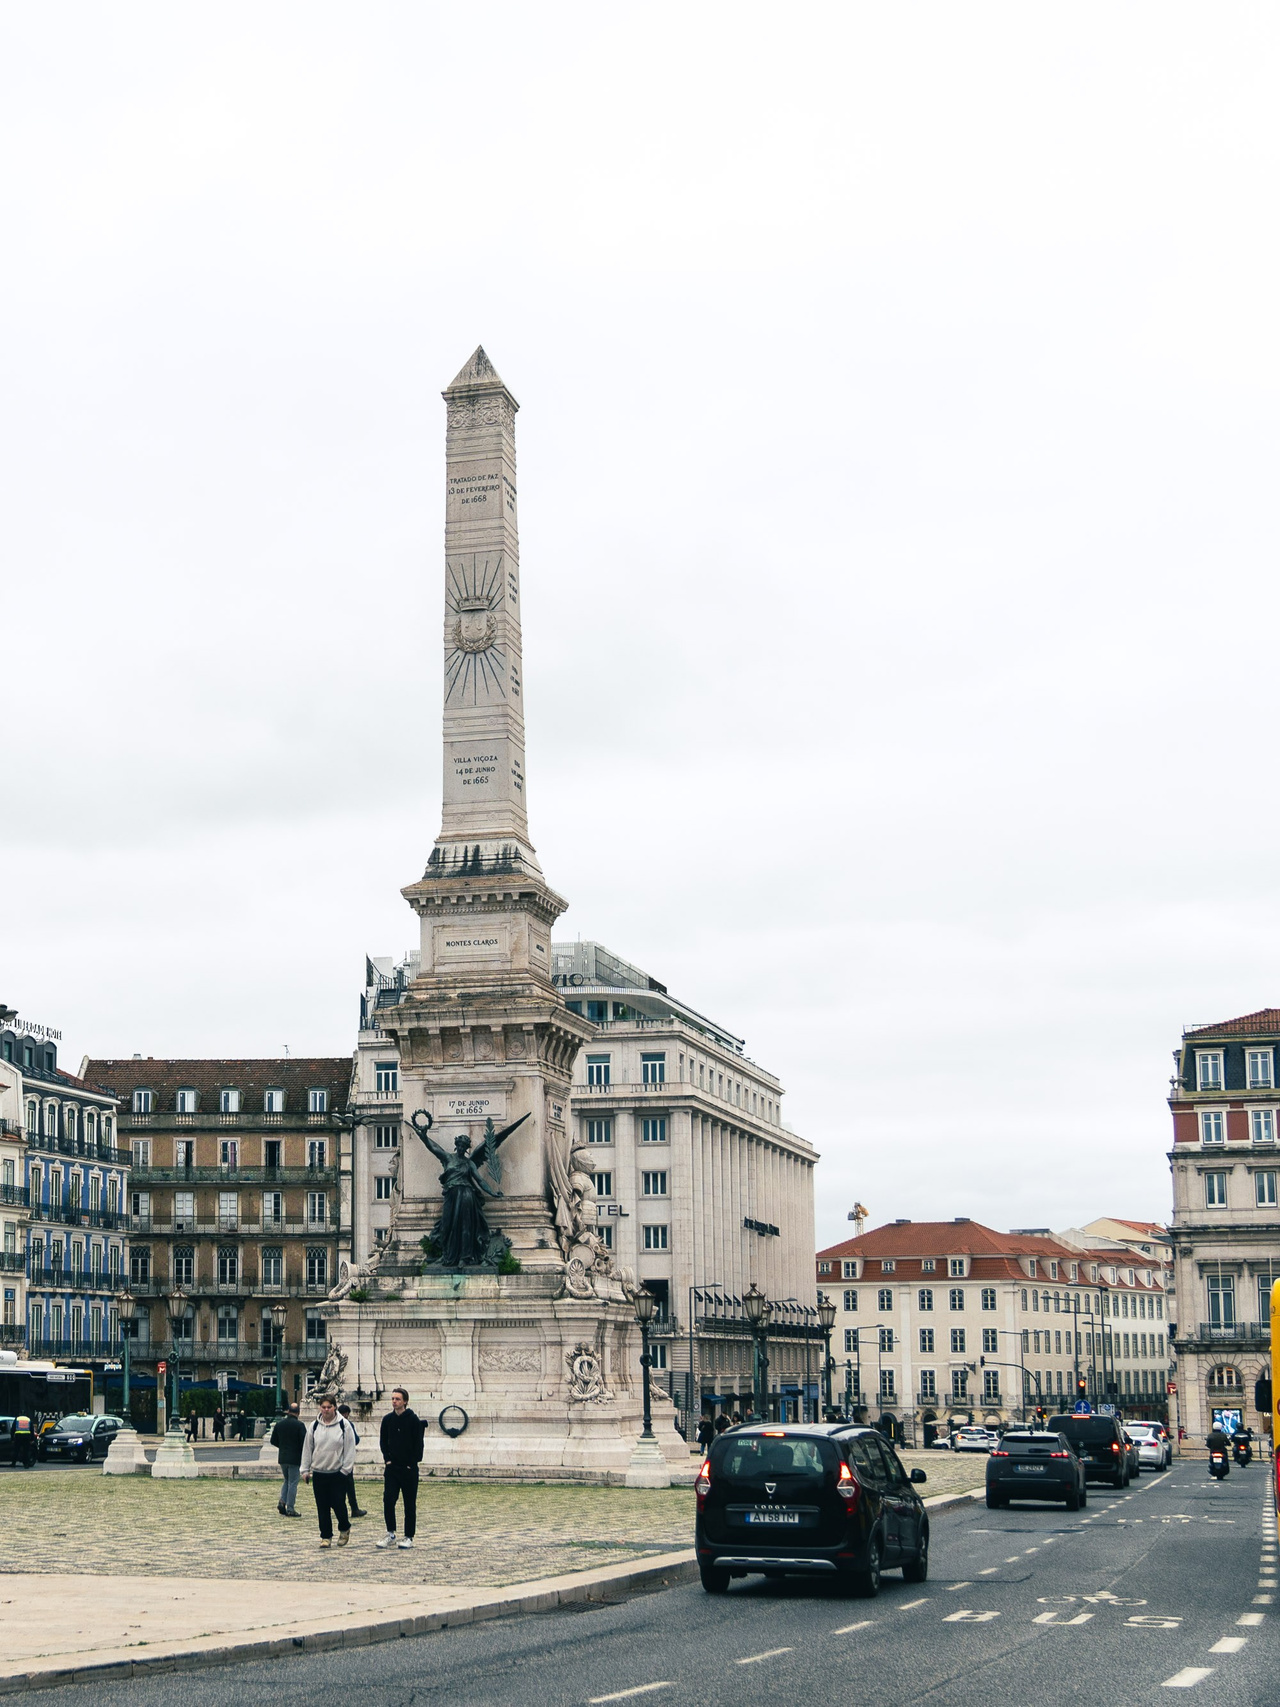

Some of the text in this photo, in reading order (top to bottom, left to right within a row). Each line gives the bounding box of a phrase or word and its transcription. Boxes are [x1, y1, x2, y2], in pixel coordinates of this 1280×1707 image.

[449, 476, 477, 484] TRATADO
[471, 495, 487, 503] 1668
[473, 755, 498, 763] VIÇOZA
[473, 776, 489, 784] 1665
[448, 1100, 456, 1108] 17
[466, 1105, 483, 1114] 1665
[942, 1609, 1184, 1629] BUS
